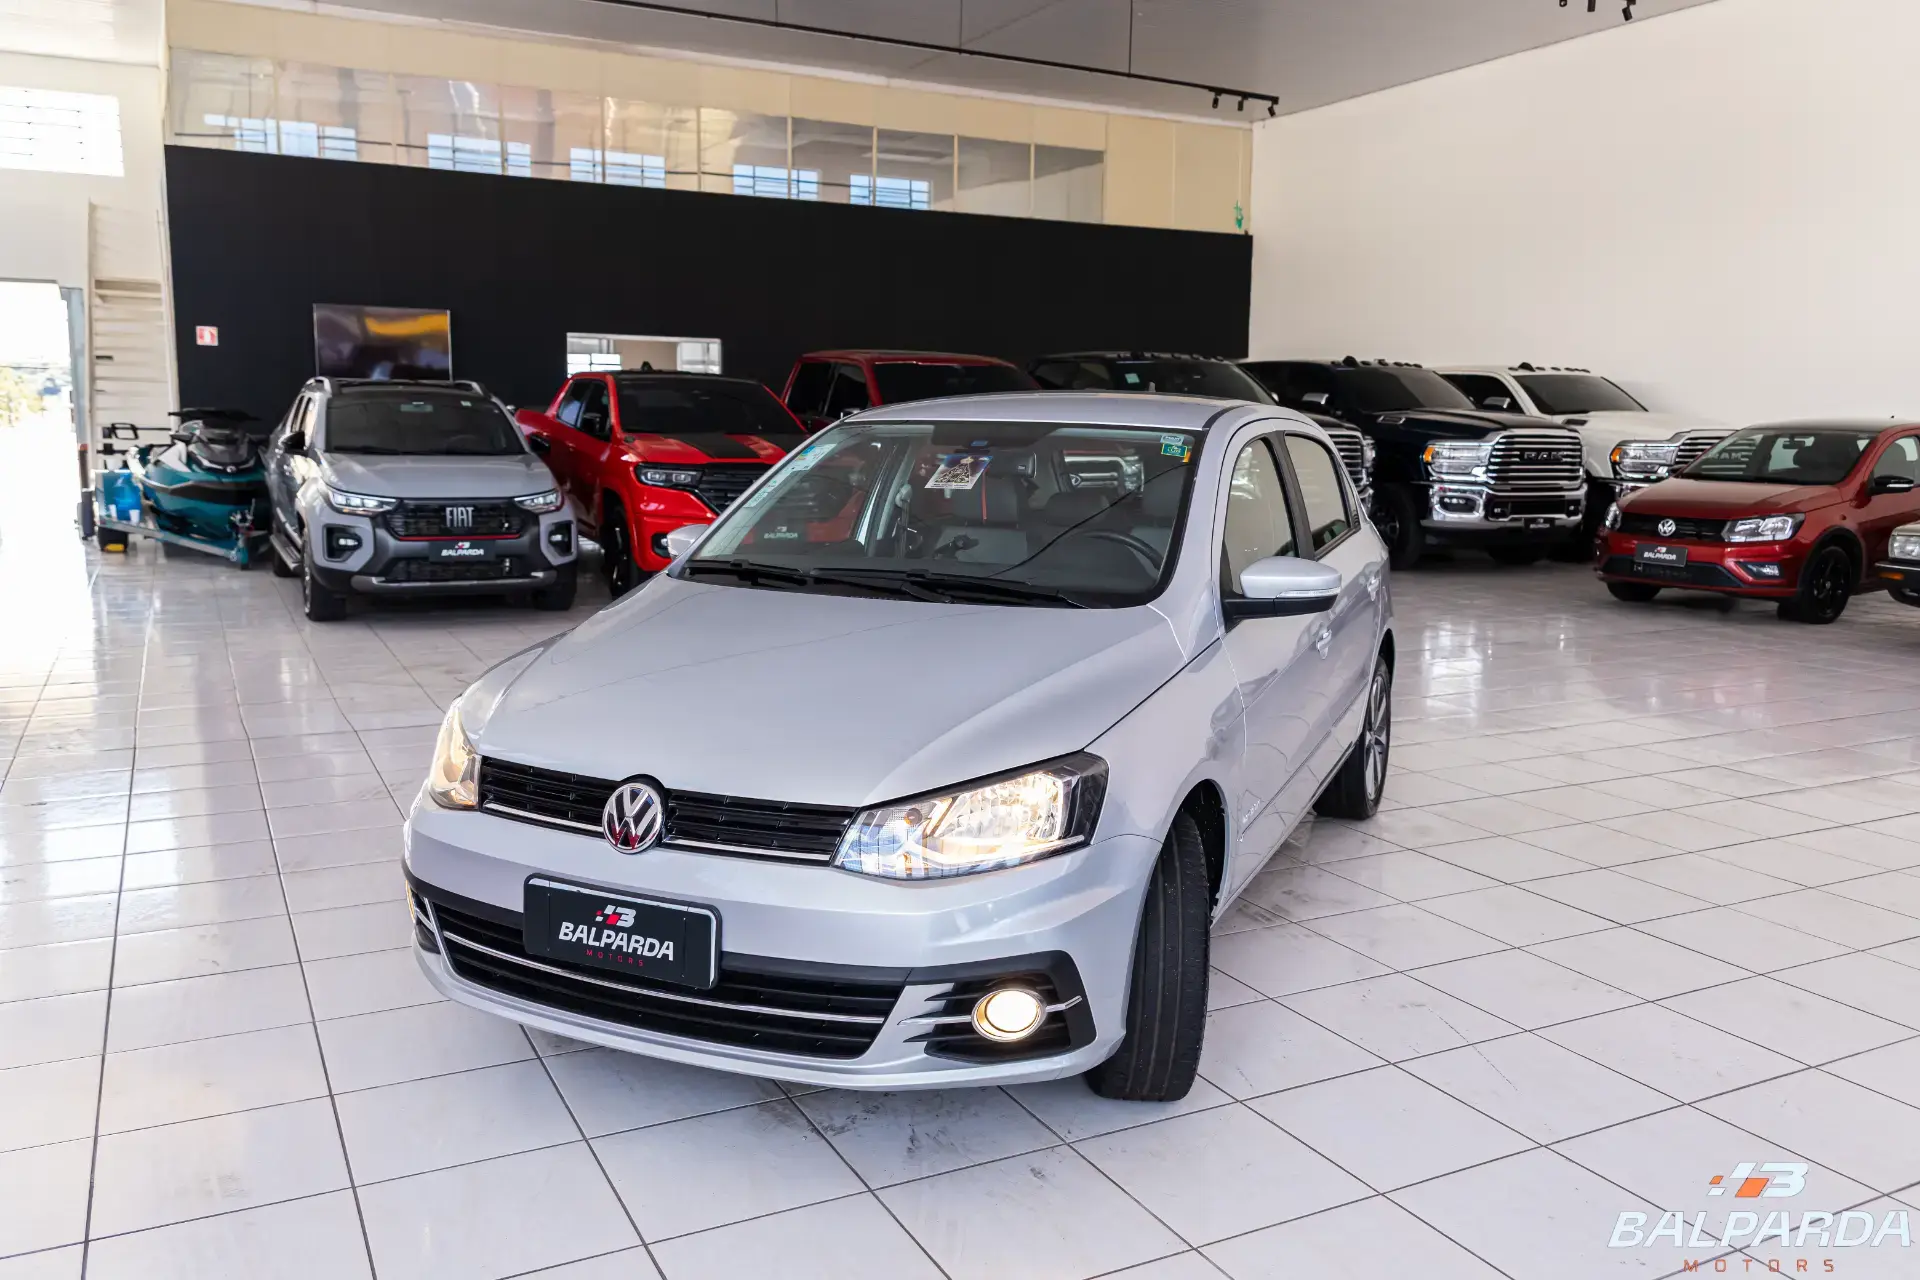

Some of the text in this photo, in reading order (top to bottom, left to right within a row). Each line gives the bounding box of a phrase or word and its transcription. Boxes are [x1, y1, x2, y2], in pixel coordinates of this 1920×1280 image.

[446, 507, 474, 527] FIAT
[1643, 551, 1677, 560] BALPARDA
[559, 921, 674, 961] BALPARDA
[586, 949, 644, 967] MOTORS
